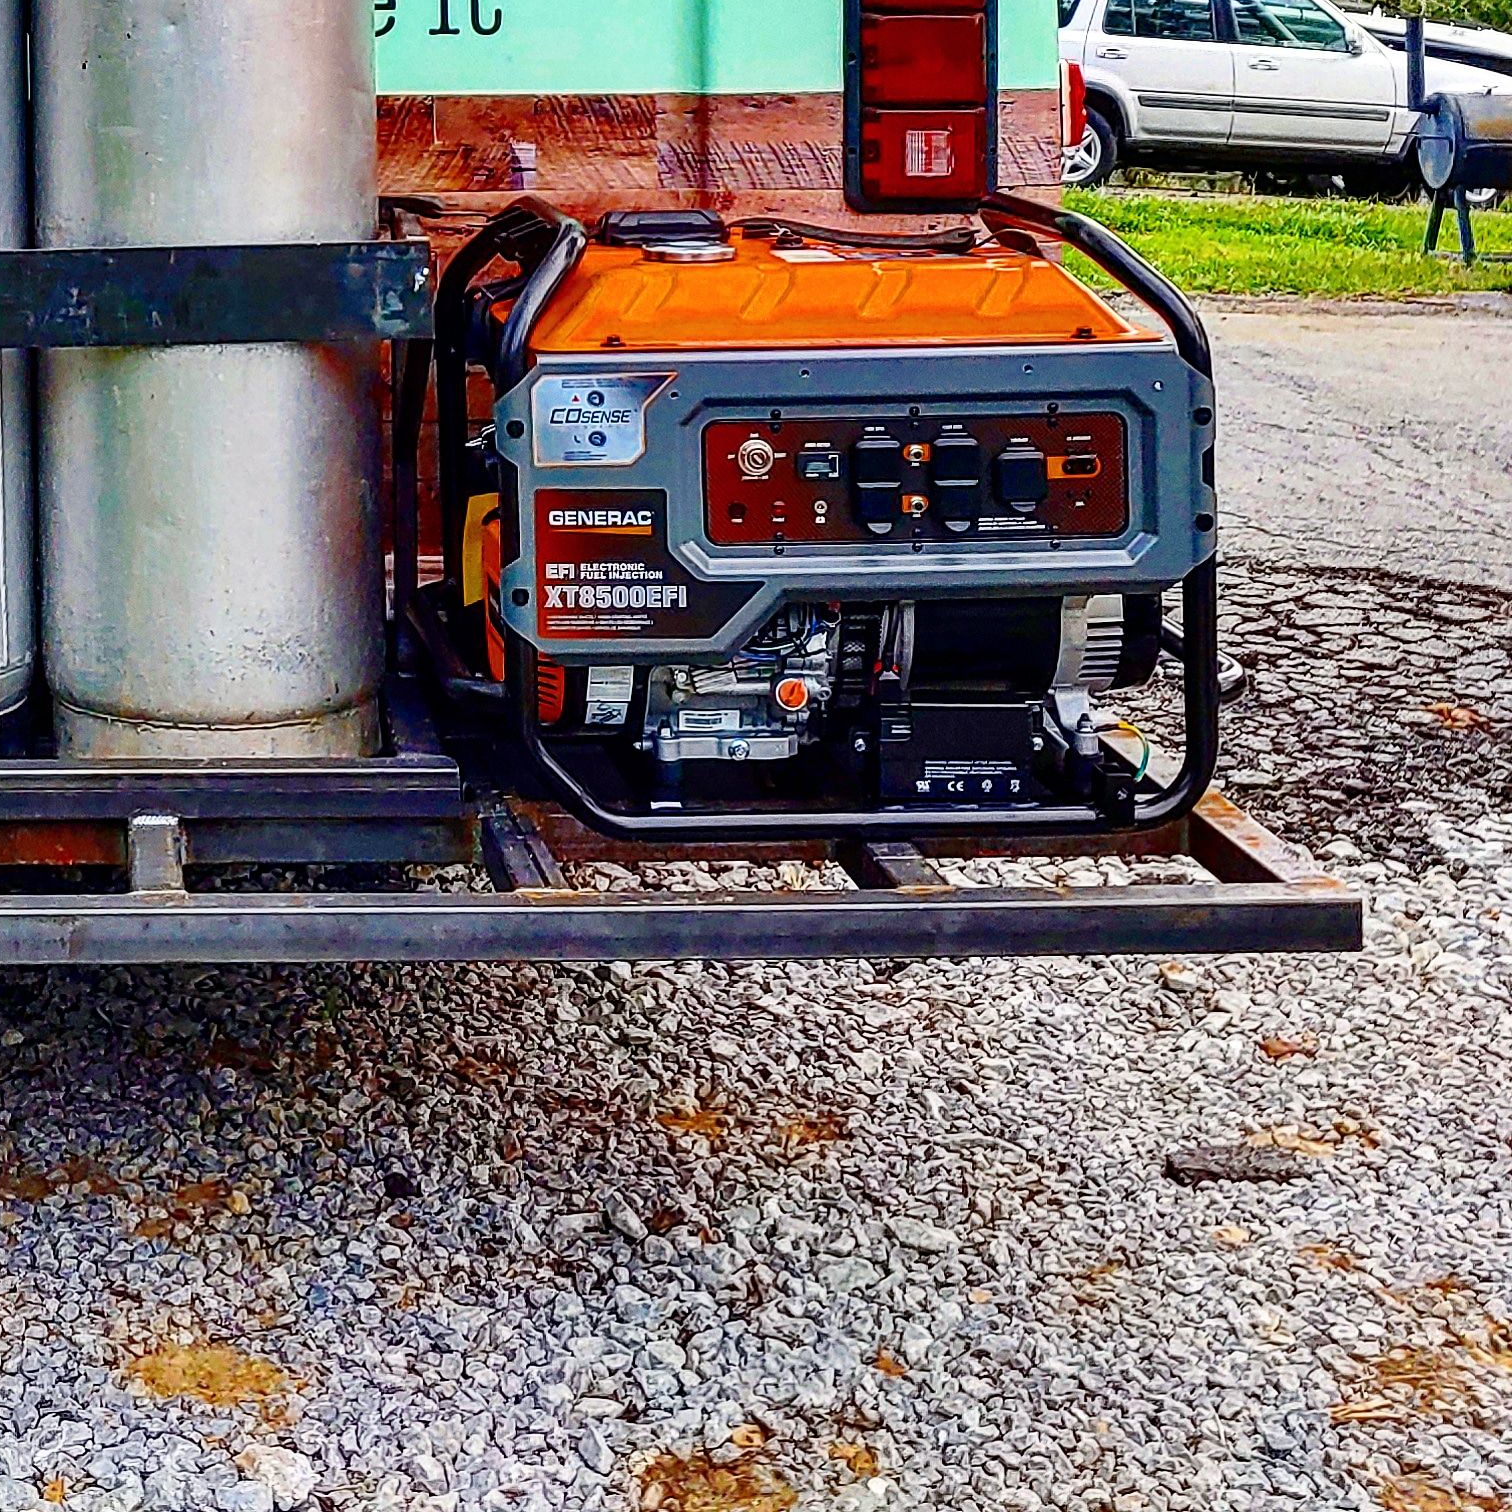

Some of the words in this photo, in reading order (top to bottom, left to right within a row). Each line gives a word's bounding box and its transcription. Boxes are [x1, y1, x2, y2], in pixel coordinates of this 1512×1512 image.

[548, 510, 652, 526] GENERAC
[545, 563, 575, 579] EFI
[580, 562, 645, 571] ELECTRONIC
[580, 570, 607, 580] FUEL
[608, 570, 663, 580] INJECTION
[544, 585, 688, 608] XT8500EFI
[947, 780, 965, 792] CE
